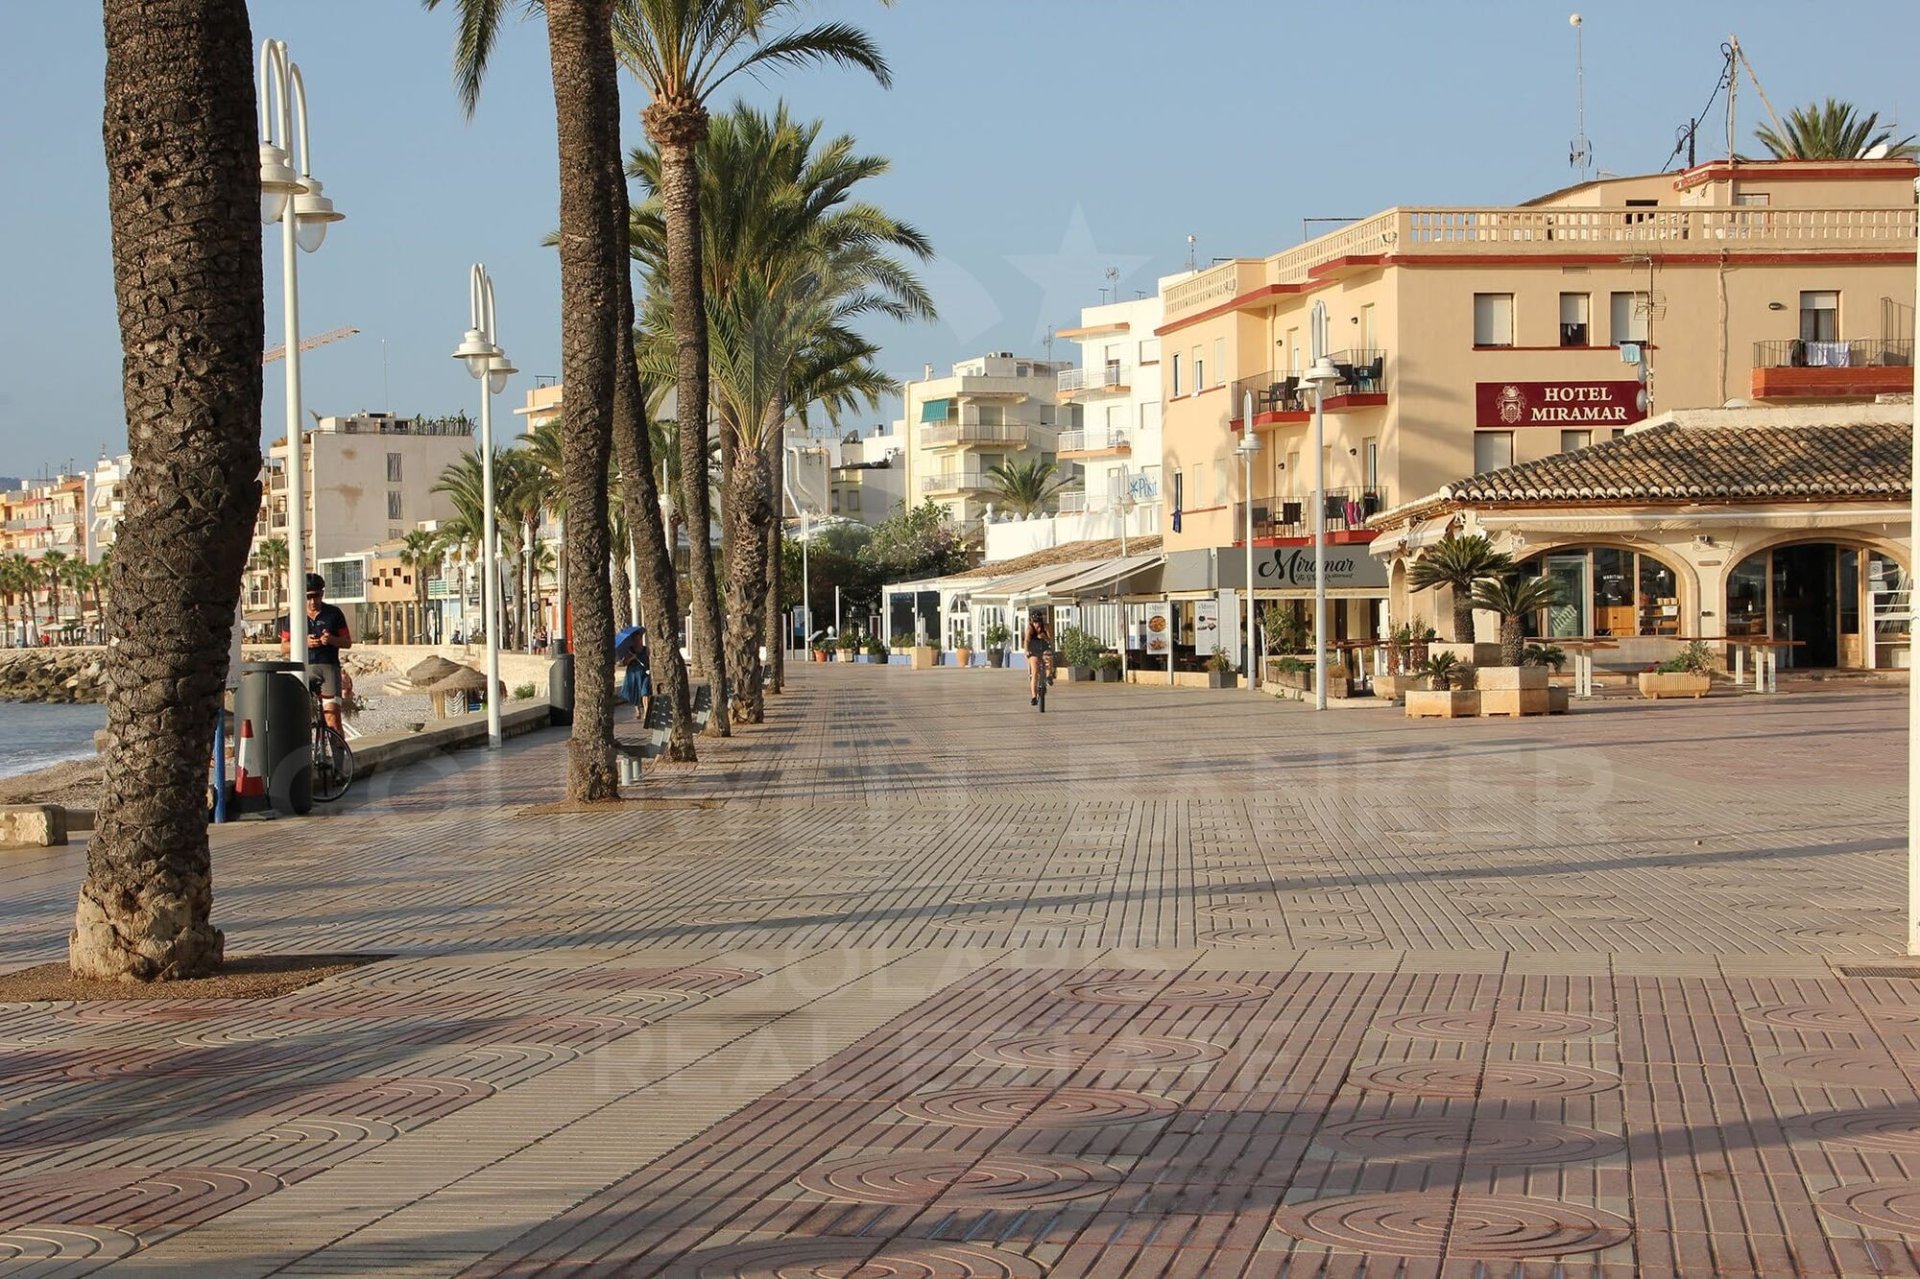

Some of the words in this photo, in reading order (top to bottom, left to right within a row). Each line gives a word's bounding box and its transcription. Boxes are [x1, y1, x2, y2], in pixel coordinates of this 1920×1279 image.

[1544, 387, 1612, 402] HOTEL
[1530, 406, 1628, 421] MIRAMAR
[1258, 549, 1355, 585] Miramar
